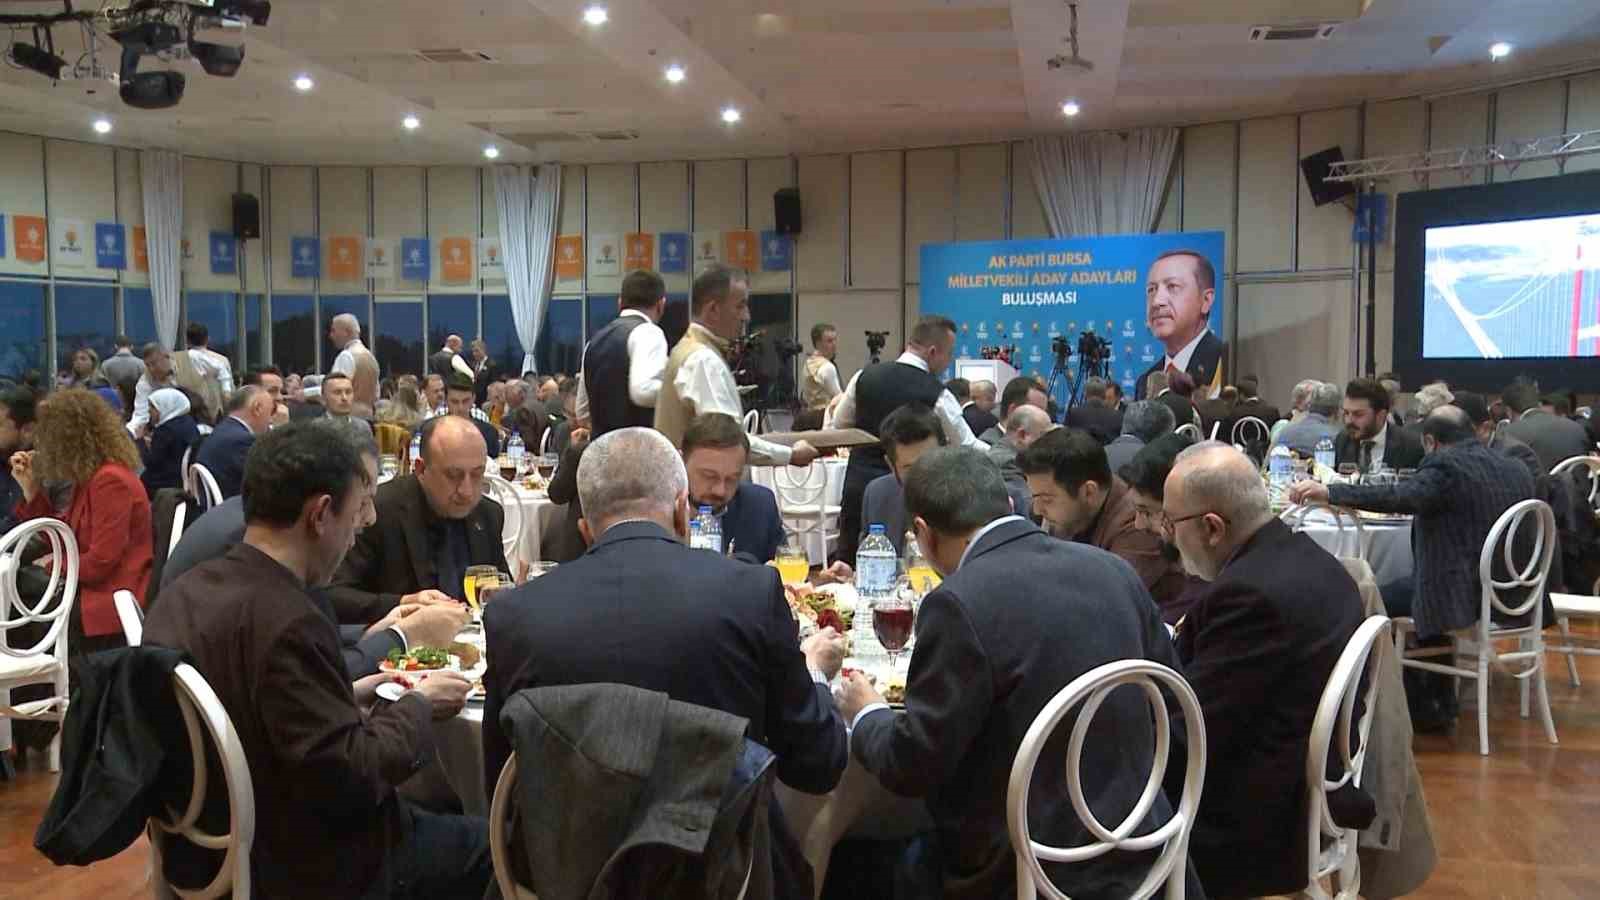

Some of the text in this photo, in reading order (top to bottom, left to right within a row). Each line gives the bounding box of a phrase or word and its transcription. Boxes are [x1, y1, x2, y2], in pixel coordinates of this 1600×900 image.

[989, 251, 1091, 269] AK PARTİ BURSA
[1032, 271, 1068, 286] ADAY
[1070, 269, 1136, 285] ADAYLARI
[1002, 291, 1077, 306] BULUŞMASI
